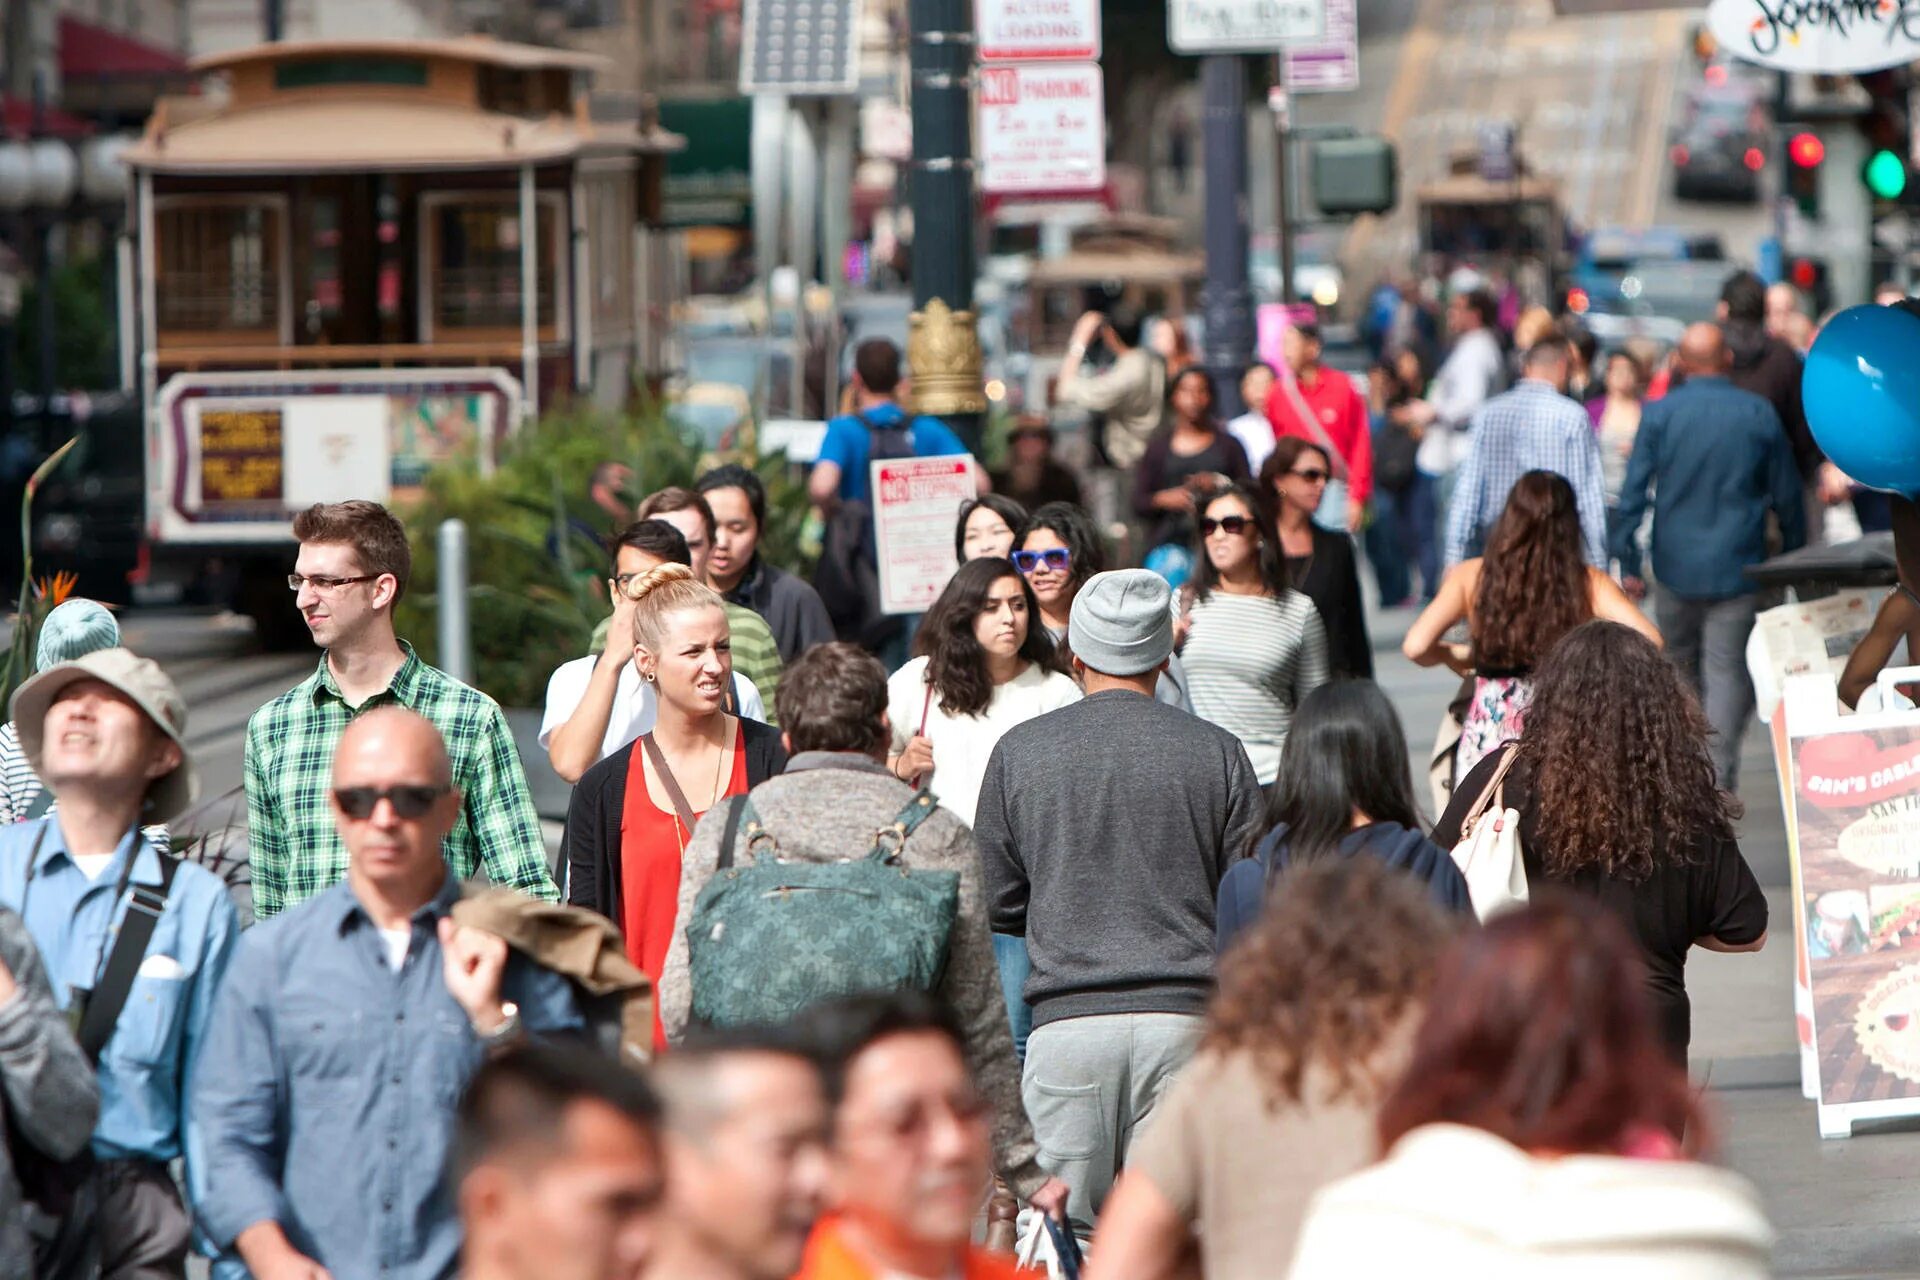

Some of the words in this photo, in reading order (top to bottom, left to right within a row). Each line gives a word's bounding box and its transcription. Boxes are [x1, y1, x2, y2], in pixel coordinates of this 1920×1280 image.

[996, 21, 1082, 39] LOADING
[981, 70, 1016, 103] NO
[1024, 78, 1091, 98] PARKING
[1807, 775, 1866, 795] SAM'S
[1870, 801, 1898, 819] SAN
